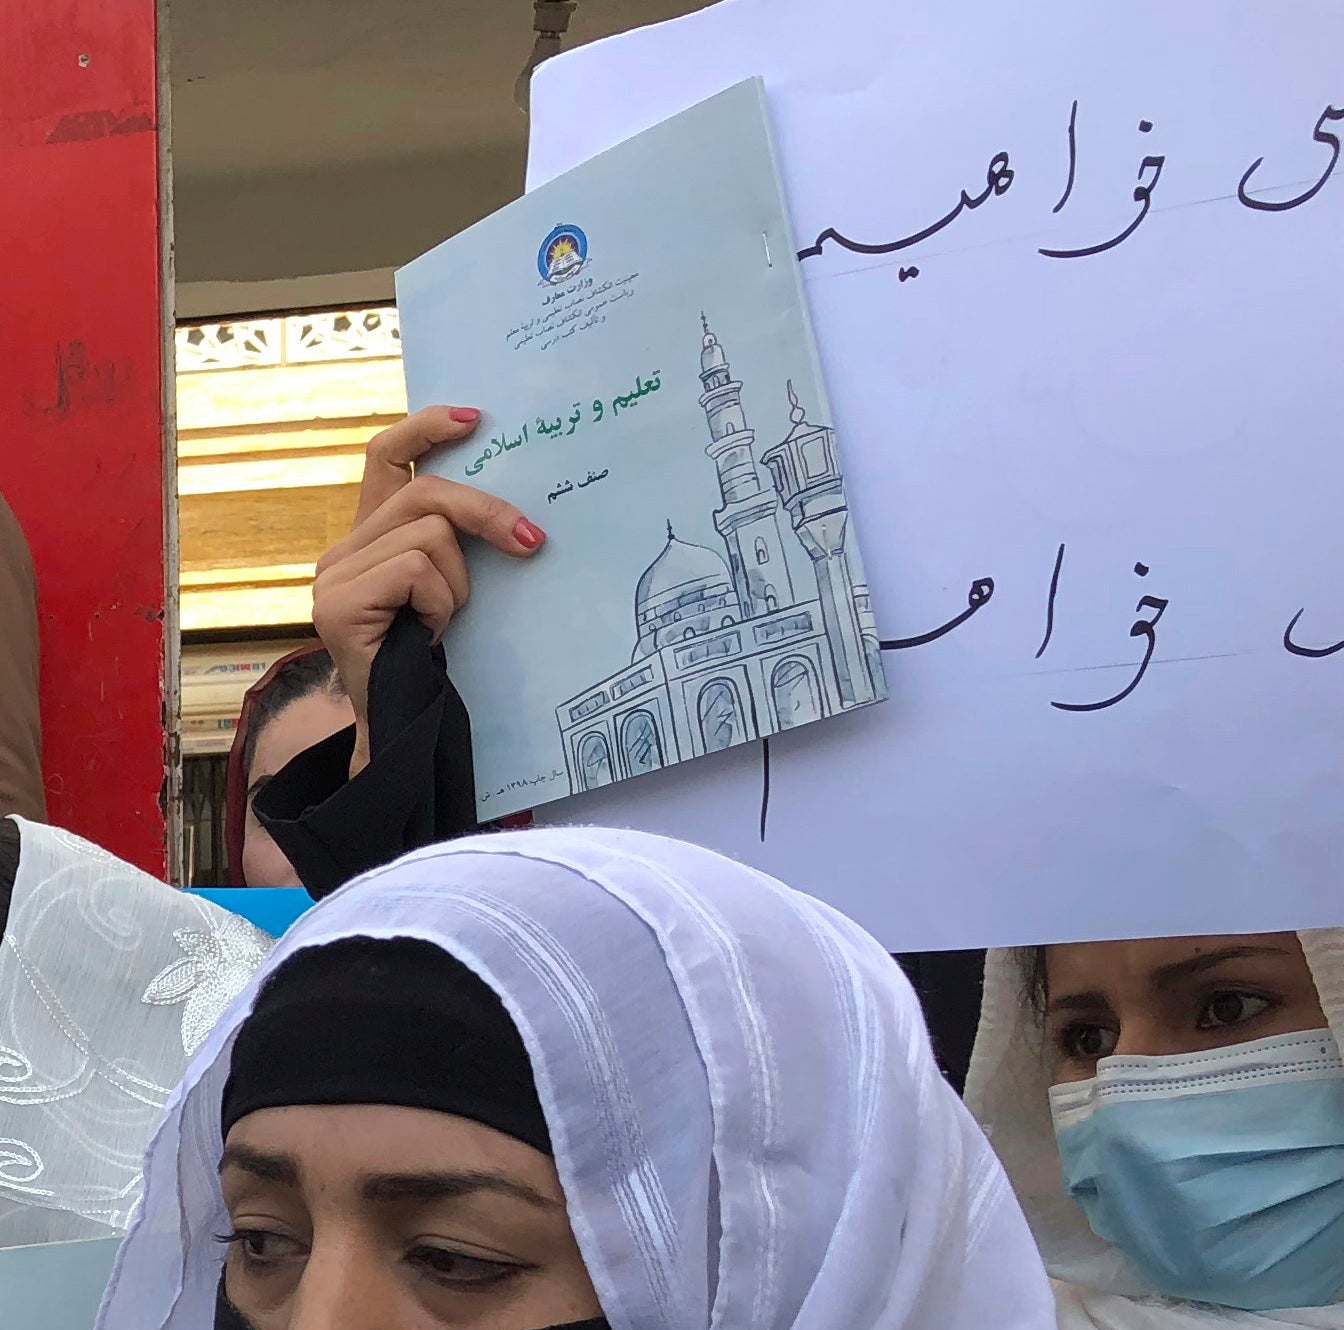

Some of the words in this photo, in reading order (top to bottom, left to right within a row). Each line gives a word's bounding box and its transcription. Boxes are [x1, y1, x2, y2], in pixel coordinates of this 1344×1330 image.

[611, 369, 662, 417] تعلیم
[591, 398, 604, 423] و
[464, 422, 530, 477] اسلامی
[576, 467, 609, 488] صنف
[546, 479, 574, 505] ششم
